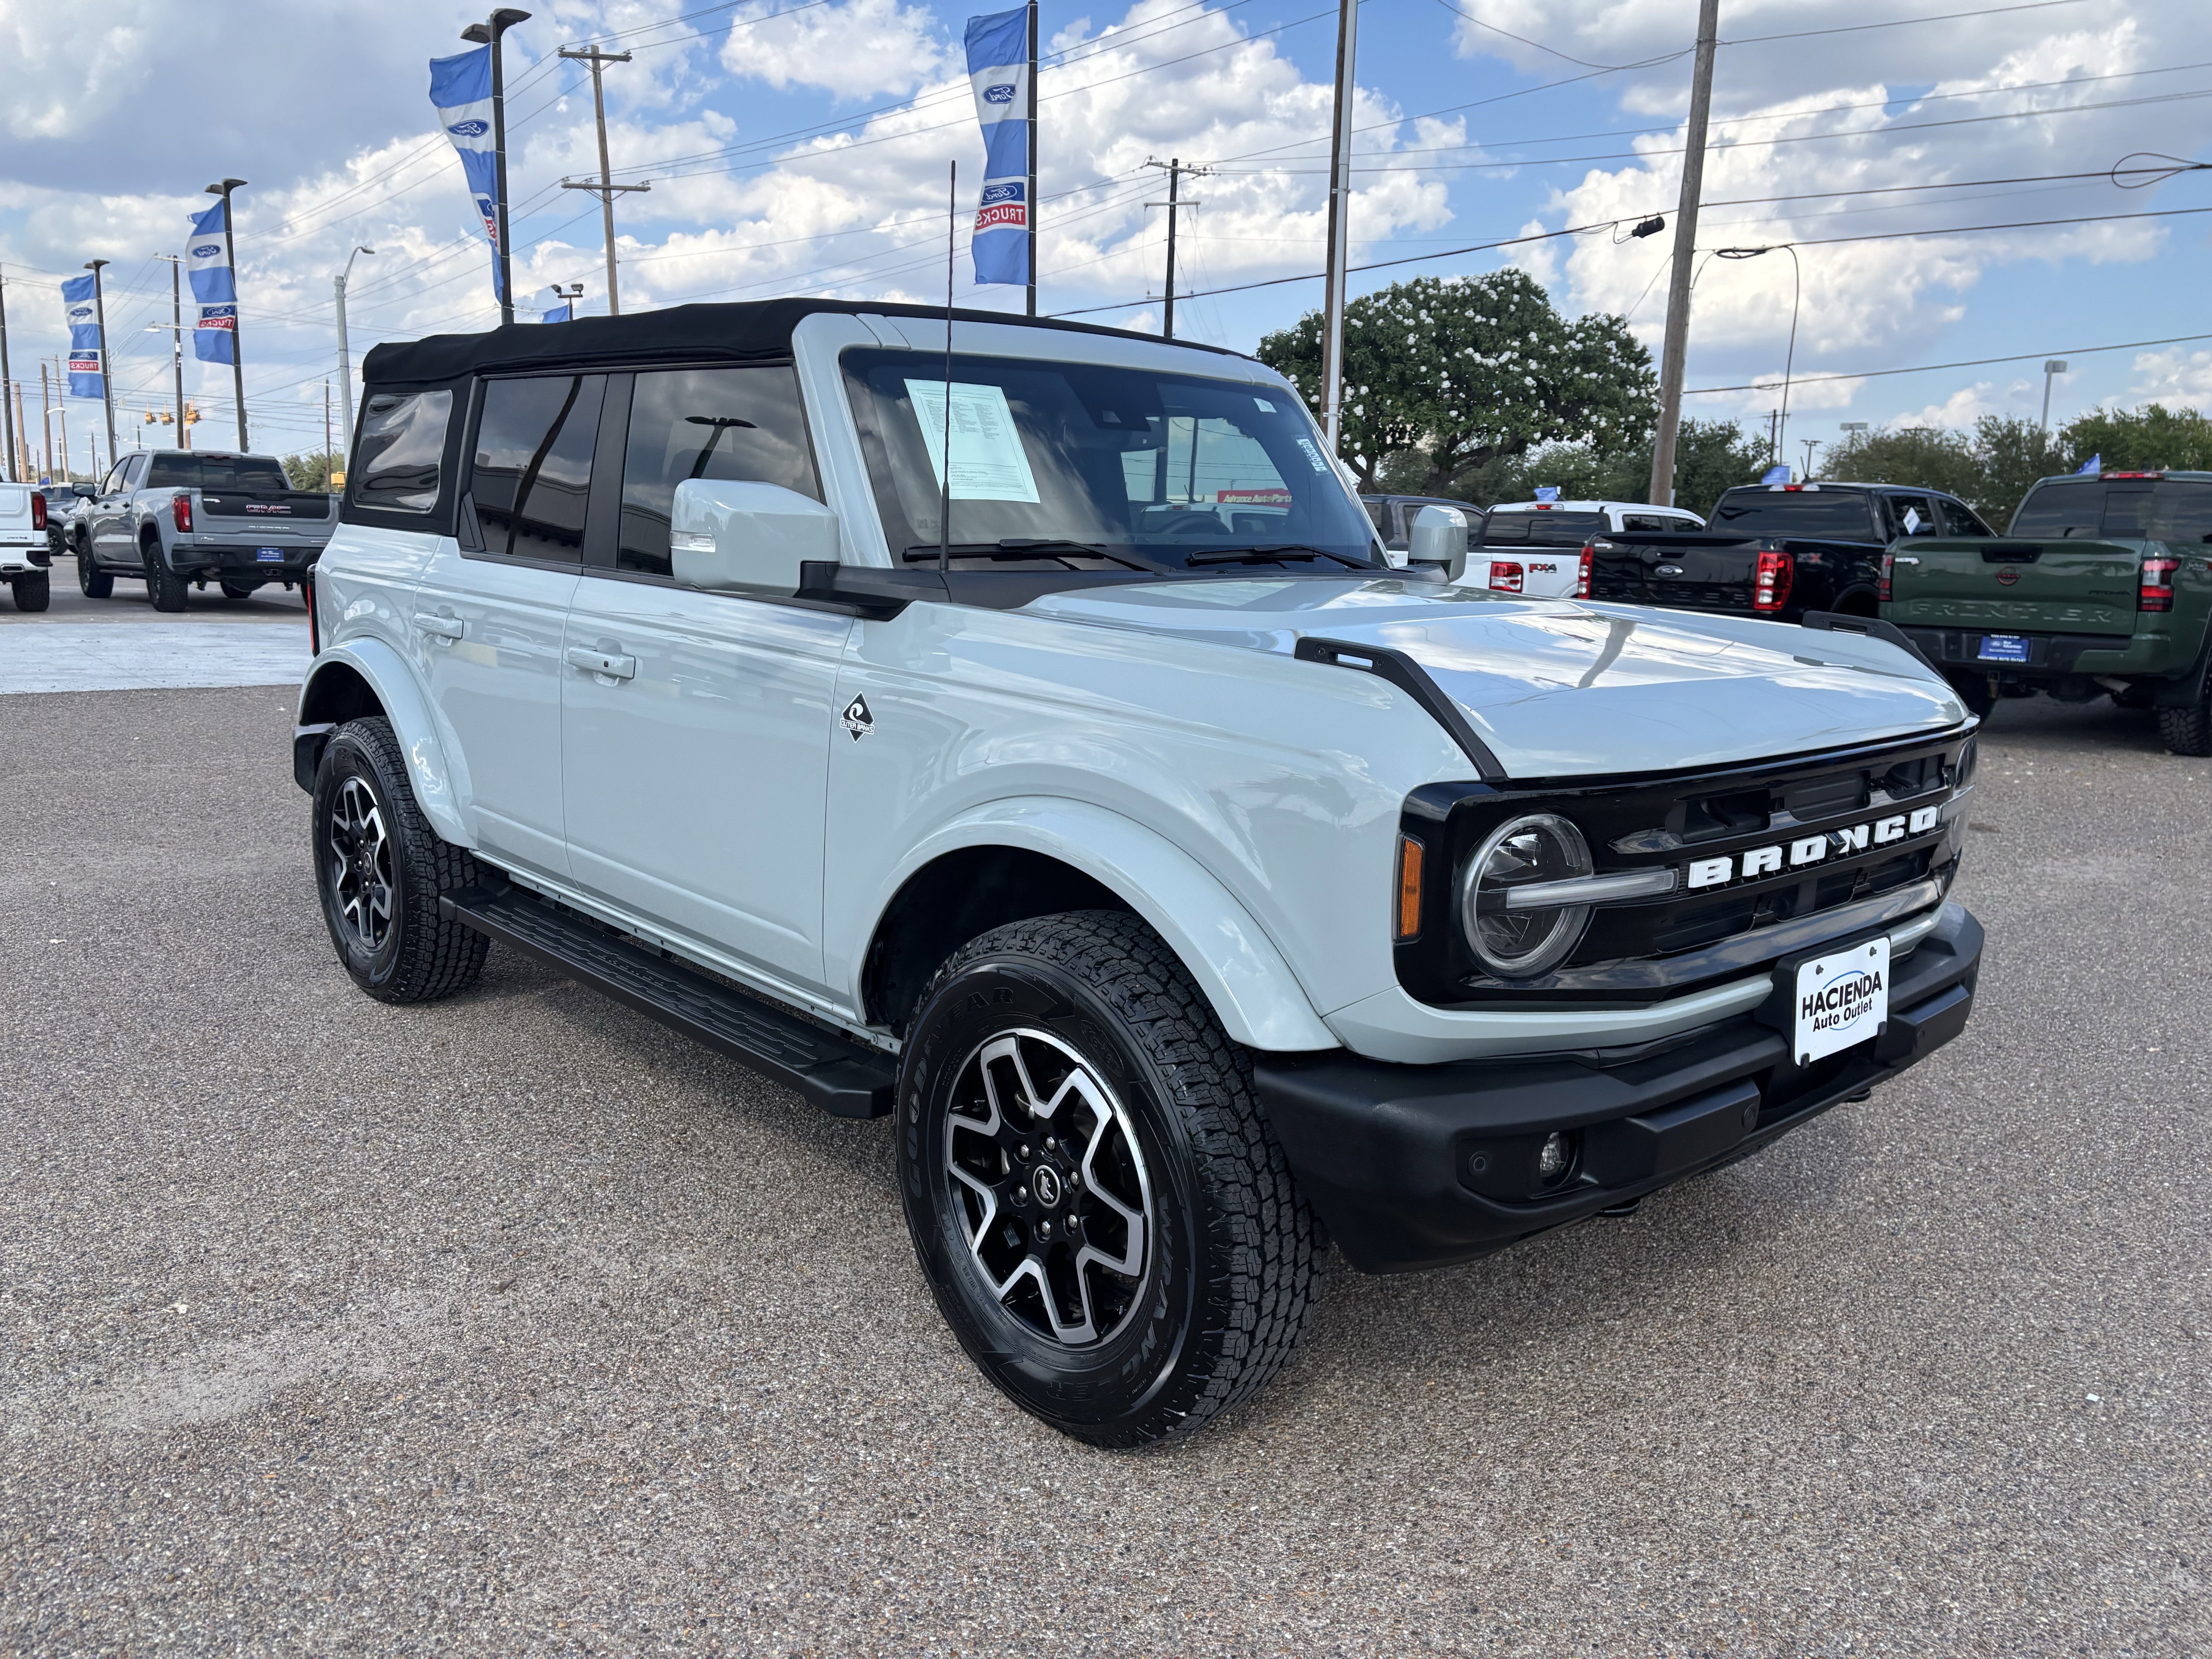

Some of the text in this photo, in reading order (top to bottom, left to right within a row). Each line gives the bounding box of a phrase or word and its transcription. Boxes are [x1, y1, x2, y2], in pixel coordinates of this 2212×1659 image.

[1252, 495, 1273, 503] Auto
[246, 505, 291, 514] GMC
[1529, 563, 1557, 573] FX4
[841, 720, 873, 733] OUTER BANKS
[1688, 806, 1937, 888] BRONCO
[1802, 971, 1882, 1020] HACIENDA
[1813, 998, 1872, 1032] Auto Outlet
